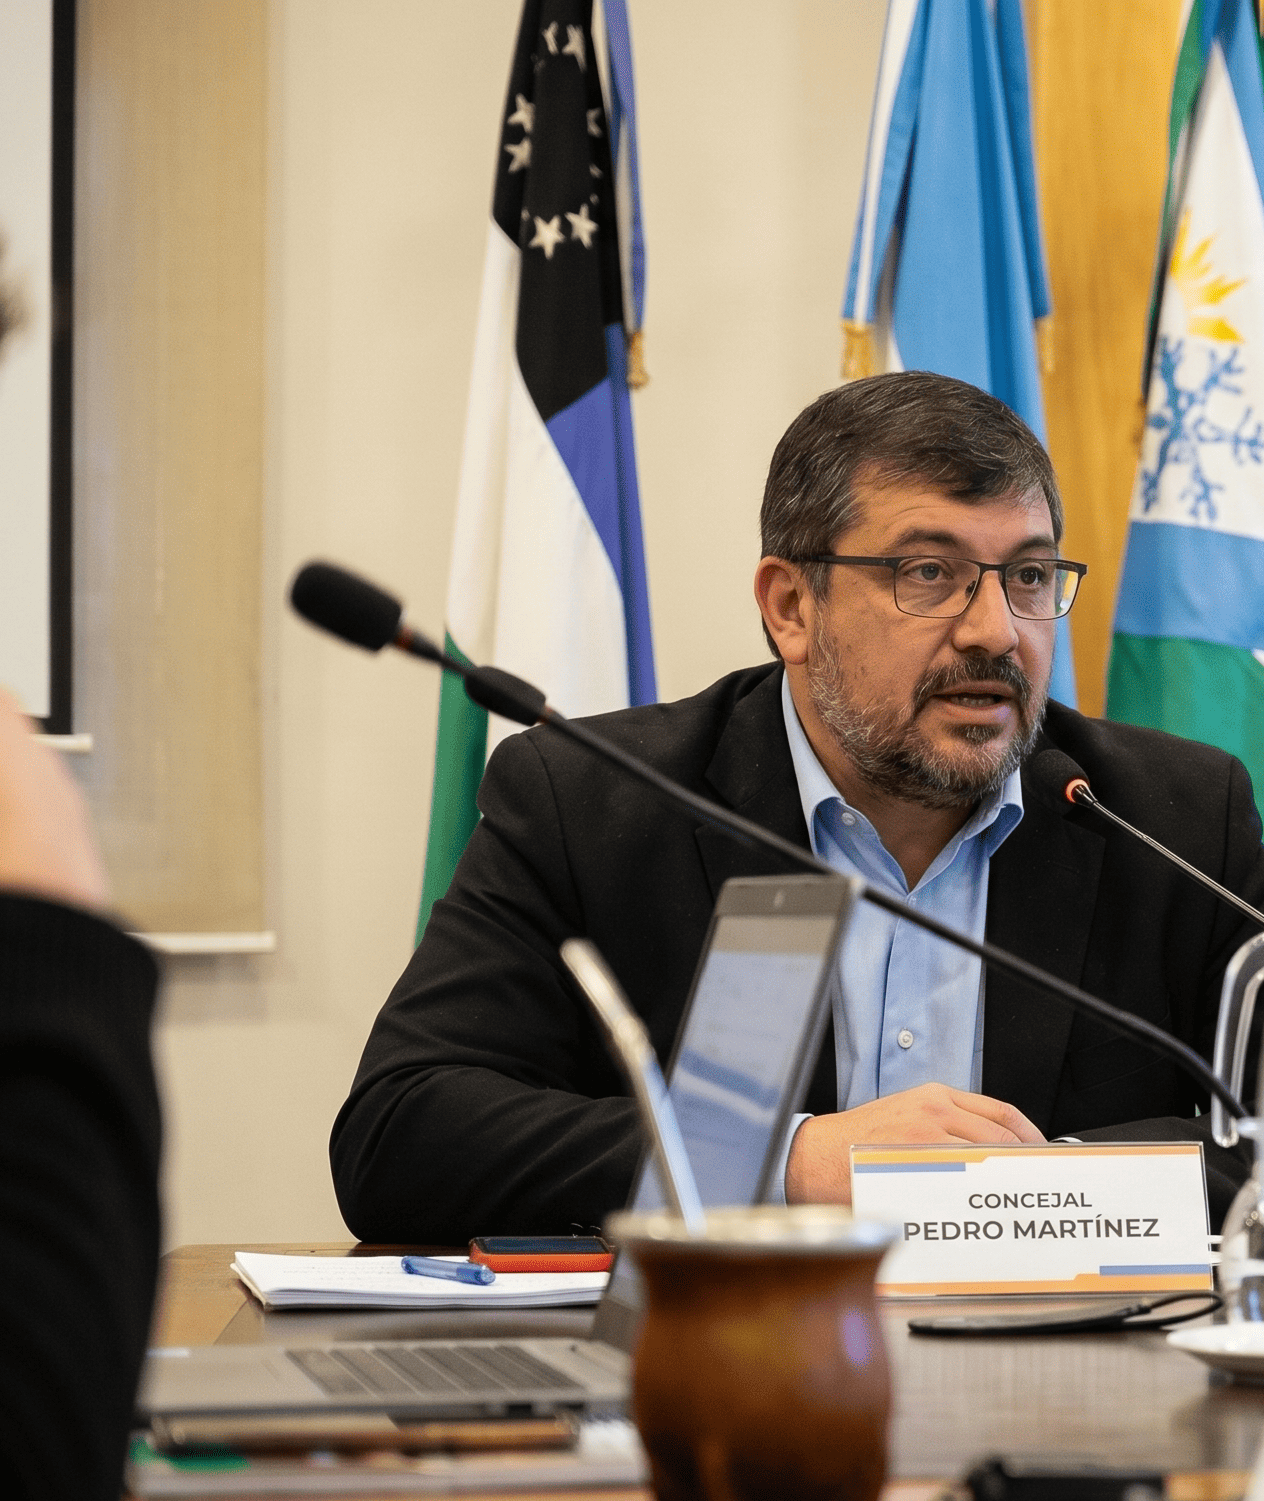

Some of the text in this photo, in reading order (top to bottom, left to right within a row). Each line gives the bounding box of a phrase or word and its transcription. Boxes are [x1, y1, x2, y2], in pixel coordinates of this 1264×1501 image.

[967, 1192, 1093, 1209] CONCEJAL
[903, 1214, 1160, 1241] PEDRO MARTÍNEZ
